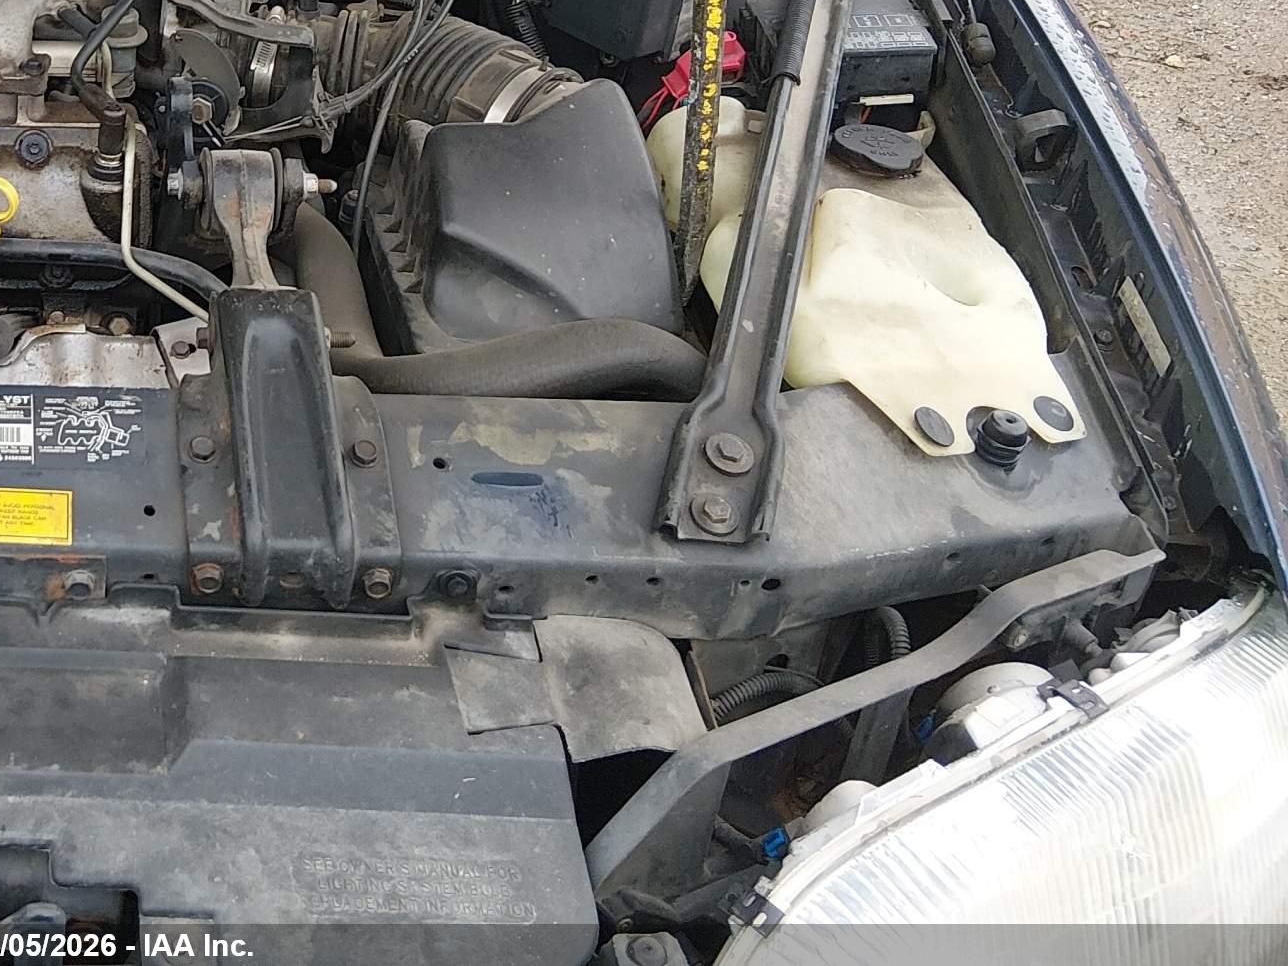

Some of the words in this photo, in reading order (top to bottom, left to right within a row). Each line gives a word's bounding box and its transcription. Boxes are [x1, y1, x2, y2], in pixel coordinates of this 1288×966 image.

[302, 857, 332, 874] SEE
[414, 862, 481, 878] MANUAL
[486, 864, 522, 881] FOR
